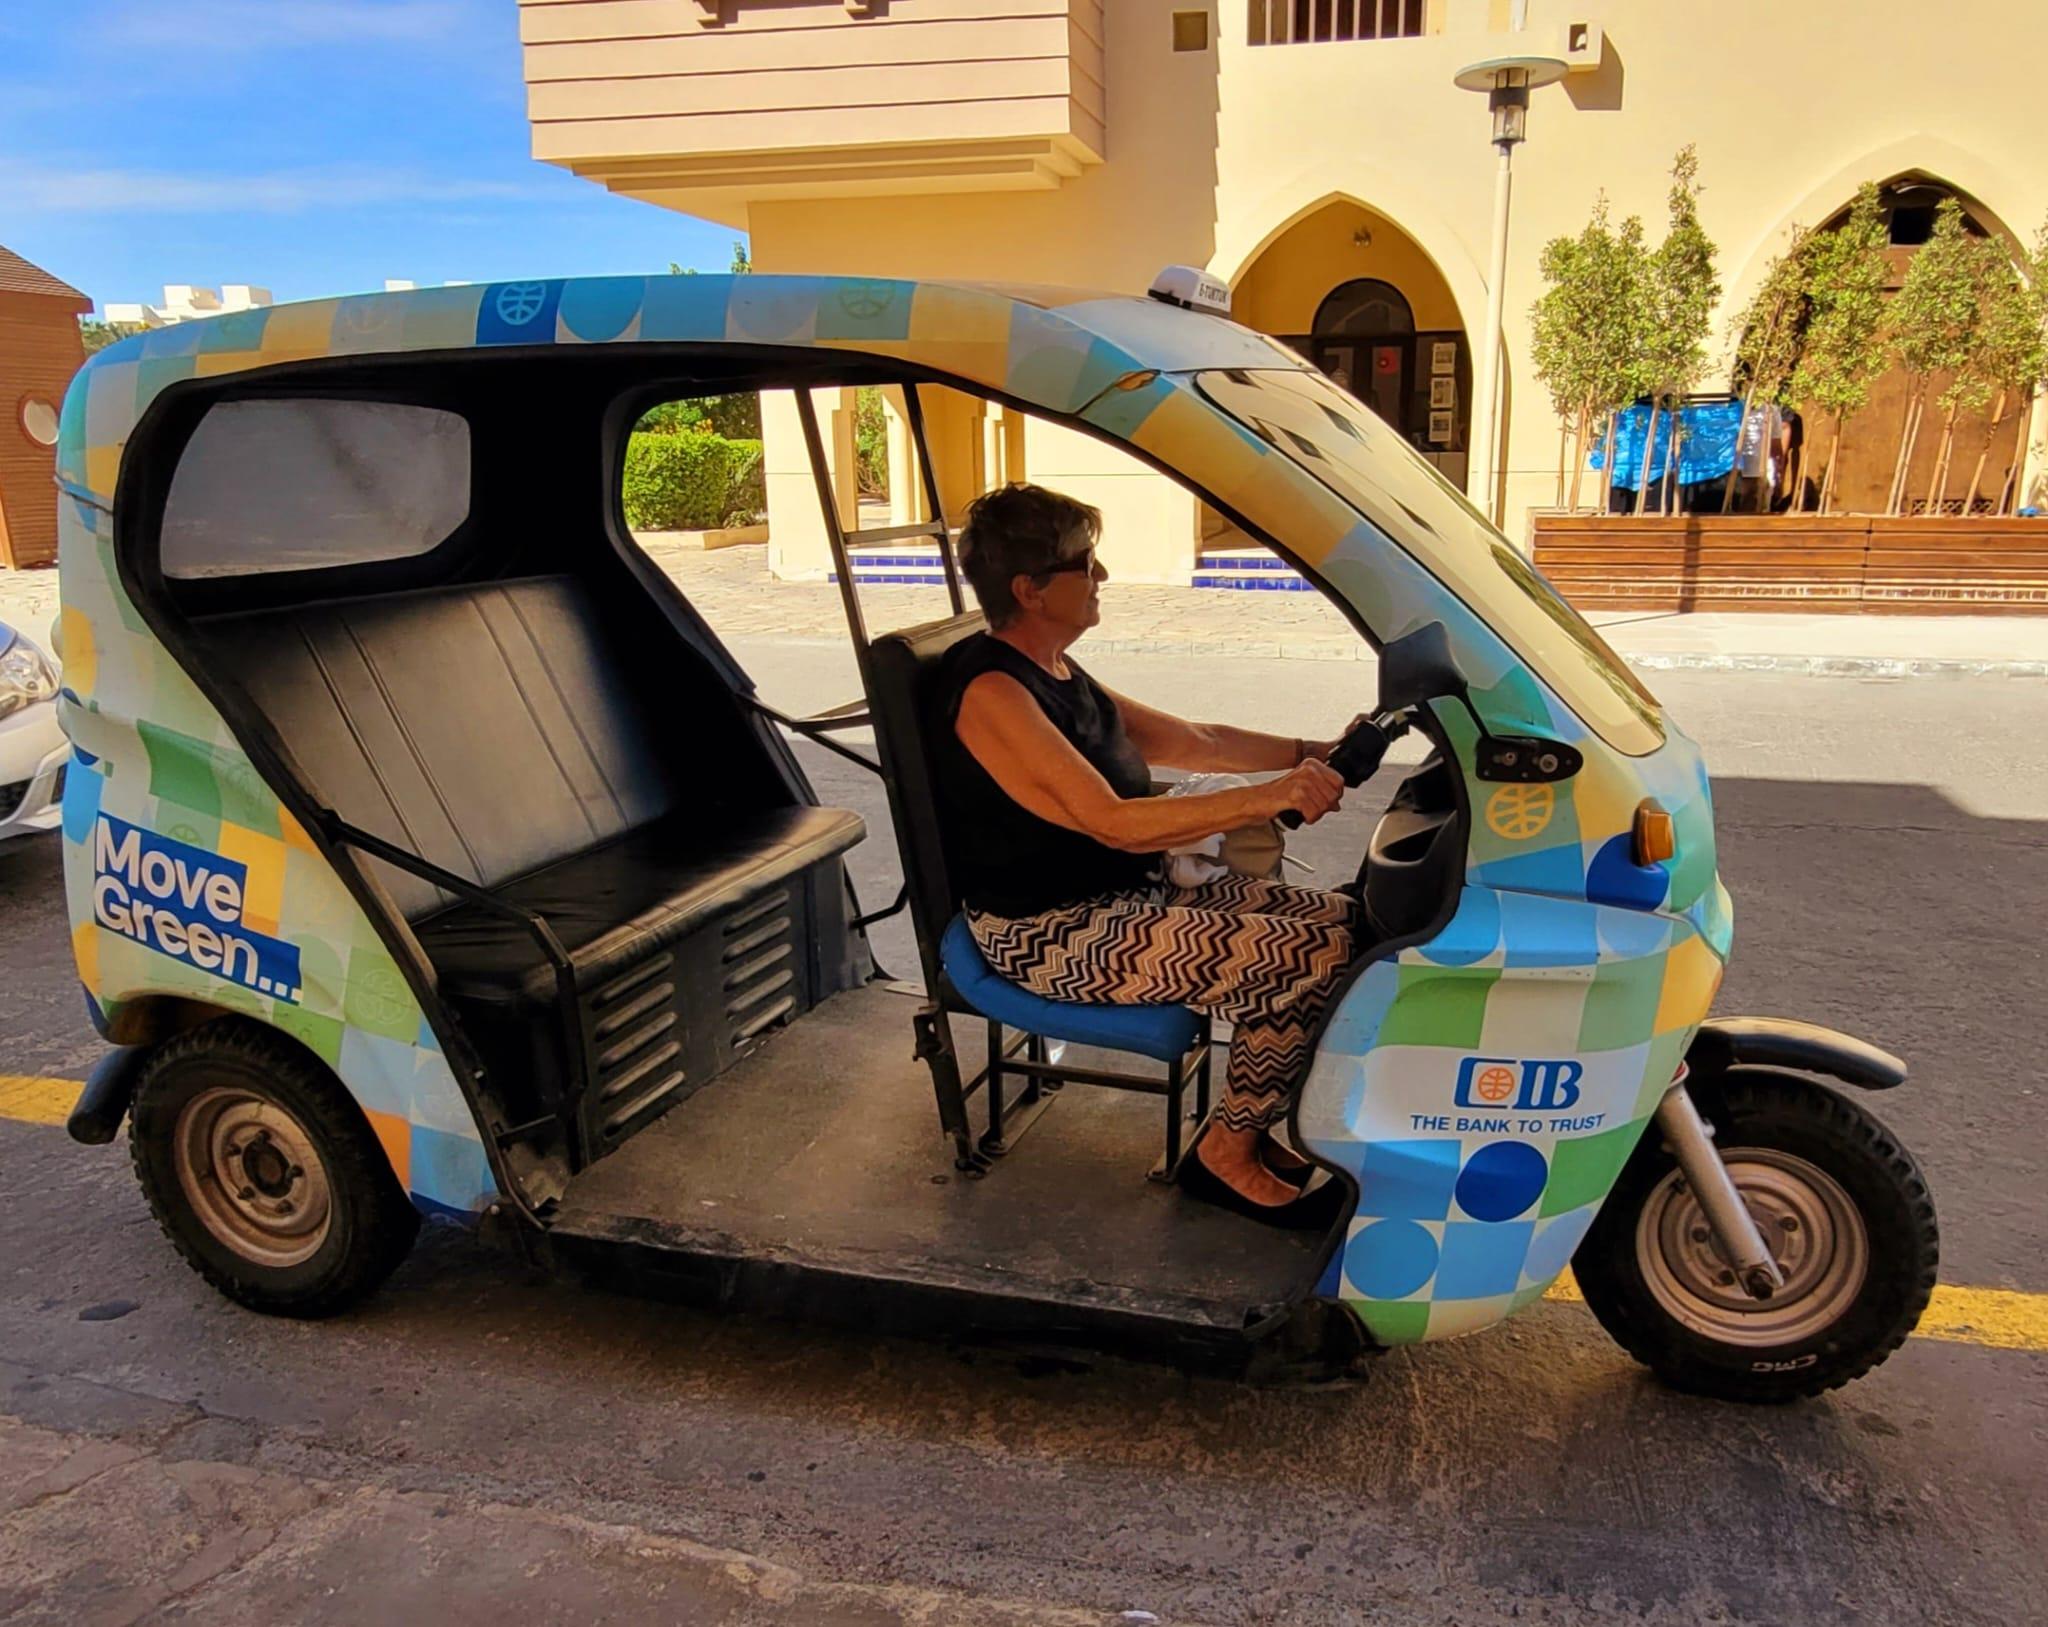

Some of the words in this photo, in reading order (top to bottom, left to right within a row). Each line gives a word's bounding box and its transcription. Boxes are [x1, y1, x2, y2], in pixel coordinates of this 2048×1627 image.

[97, 817, 241, 922] Move
[1454, 1057, 1583, 1110] CIB
[1411, 1114, 1449, 1130] THE
[1456, 1118, 1511, 1133] BANK
[1518, 1119, 1543, 1133] TO
[1550, 1113, 1606, 1132] TRUST
